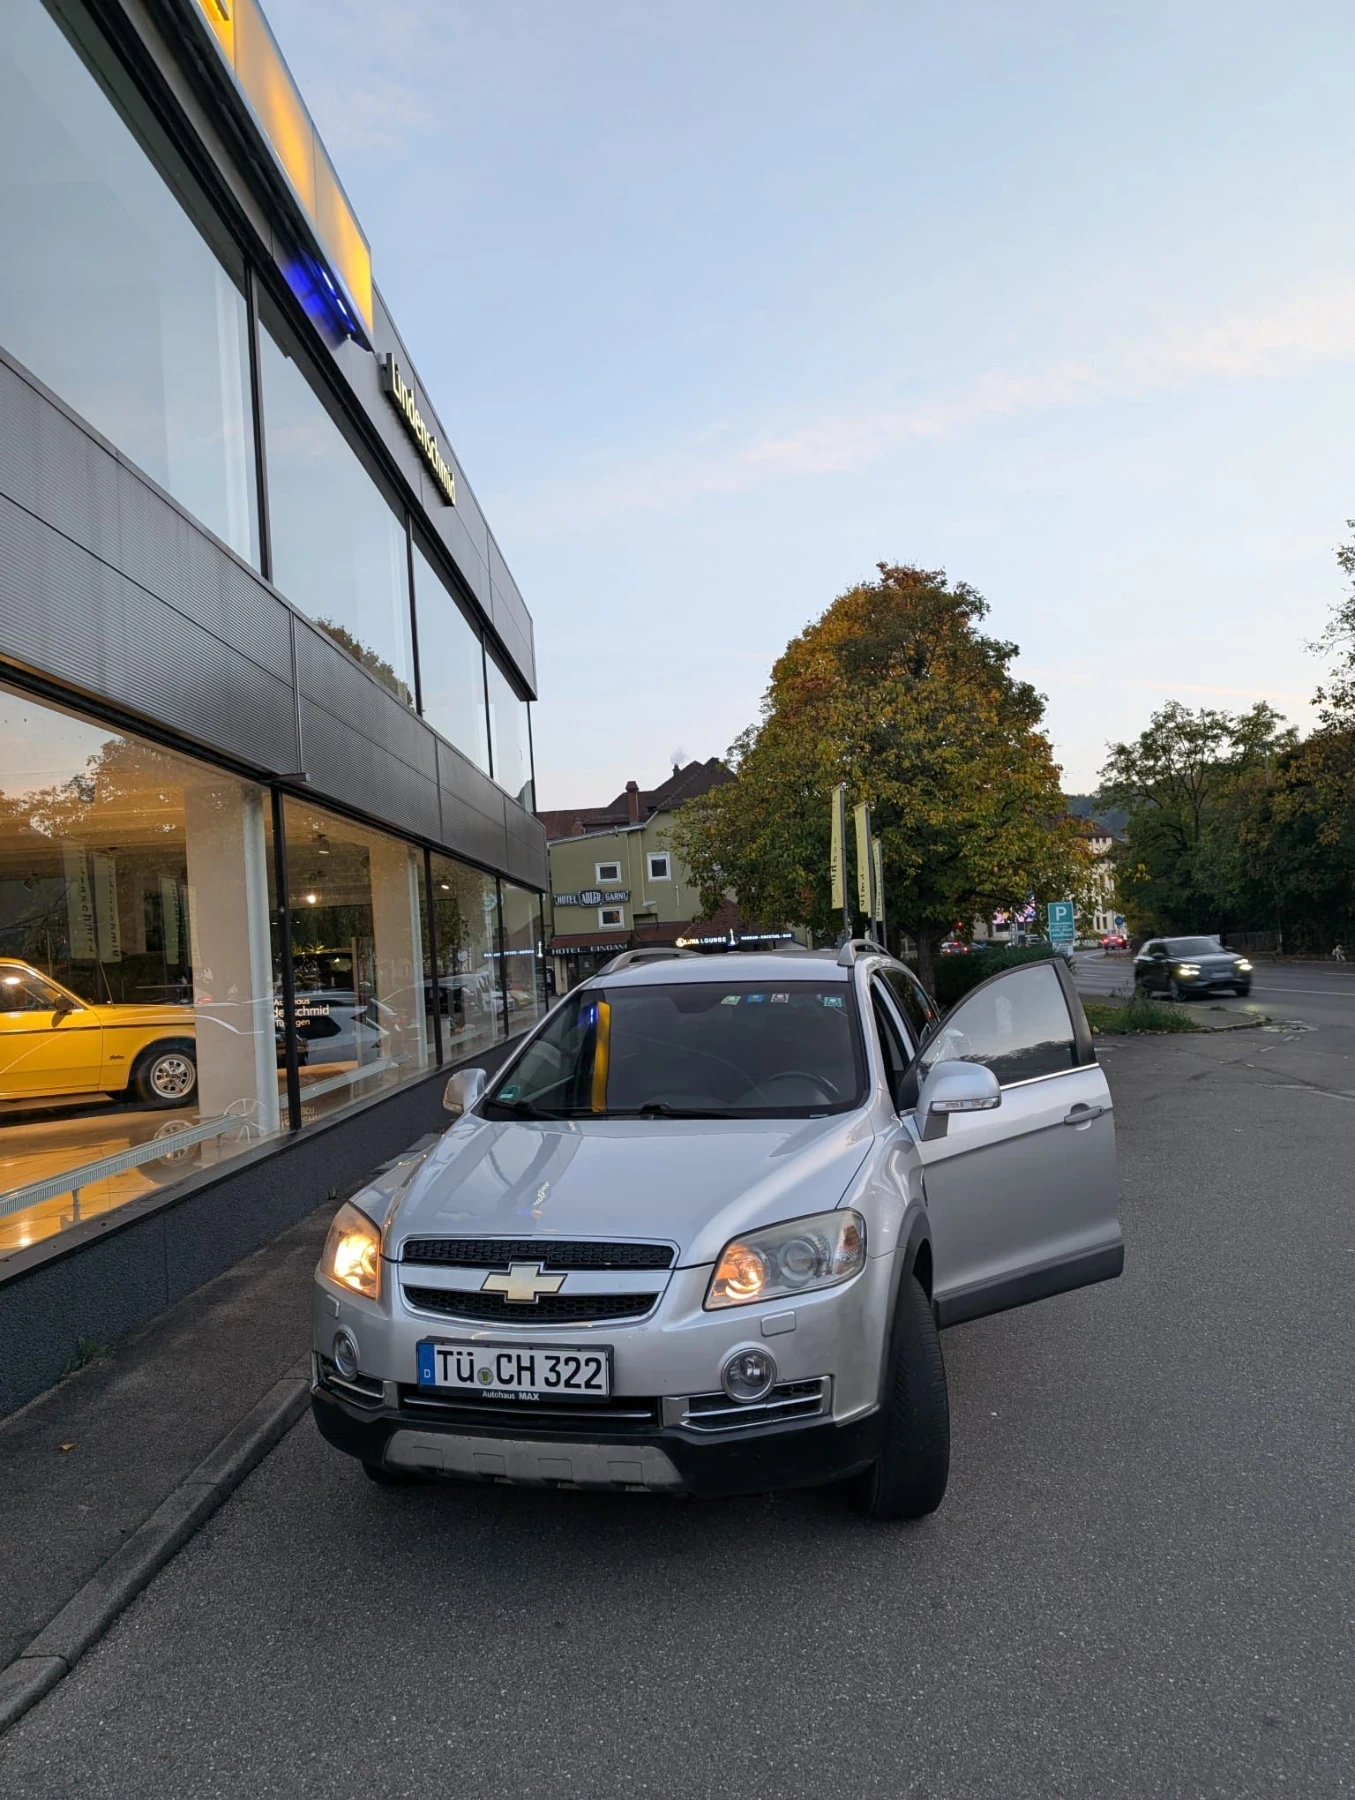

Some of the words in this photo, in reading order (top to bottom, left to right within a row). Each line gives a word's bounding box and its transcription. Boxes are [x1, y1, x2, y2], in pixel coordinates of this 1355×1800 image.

[391, 352, 456, 506] Lindenschmid
[557, 895, 577, 904] HOTEL
[581, 891, 601, 904] ADLER
[605, 892, 626, 901] GARNI
[1055, 906, 1067, 921] P
[700, 936, 727, 944] LOUNGE
[552, 947, 583, 955] HOTEL
[424, 1369, 431, 1379] D
[436, 1350, 474, 1383] TÜ
[496, 1353, 535, 1387] CH
[544, 1355, 602, 1390] 322
[482, 1390, 515, 1400] Autohaus
[519, 1392, 540, 1401] MAX
